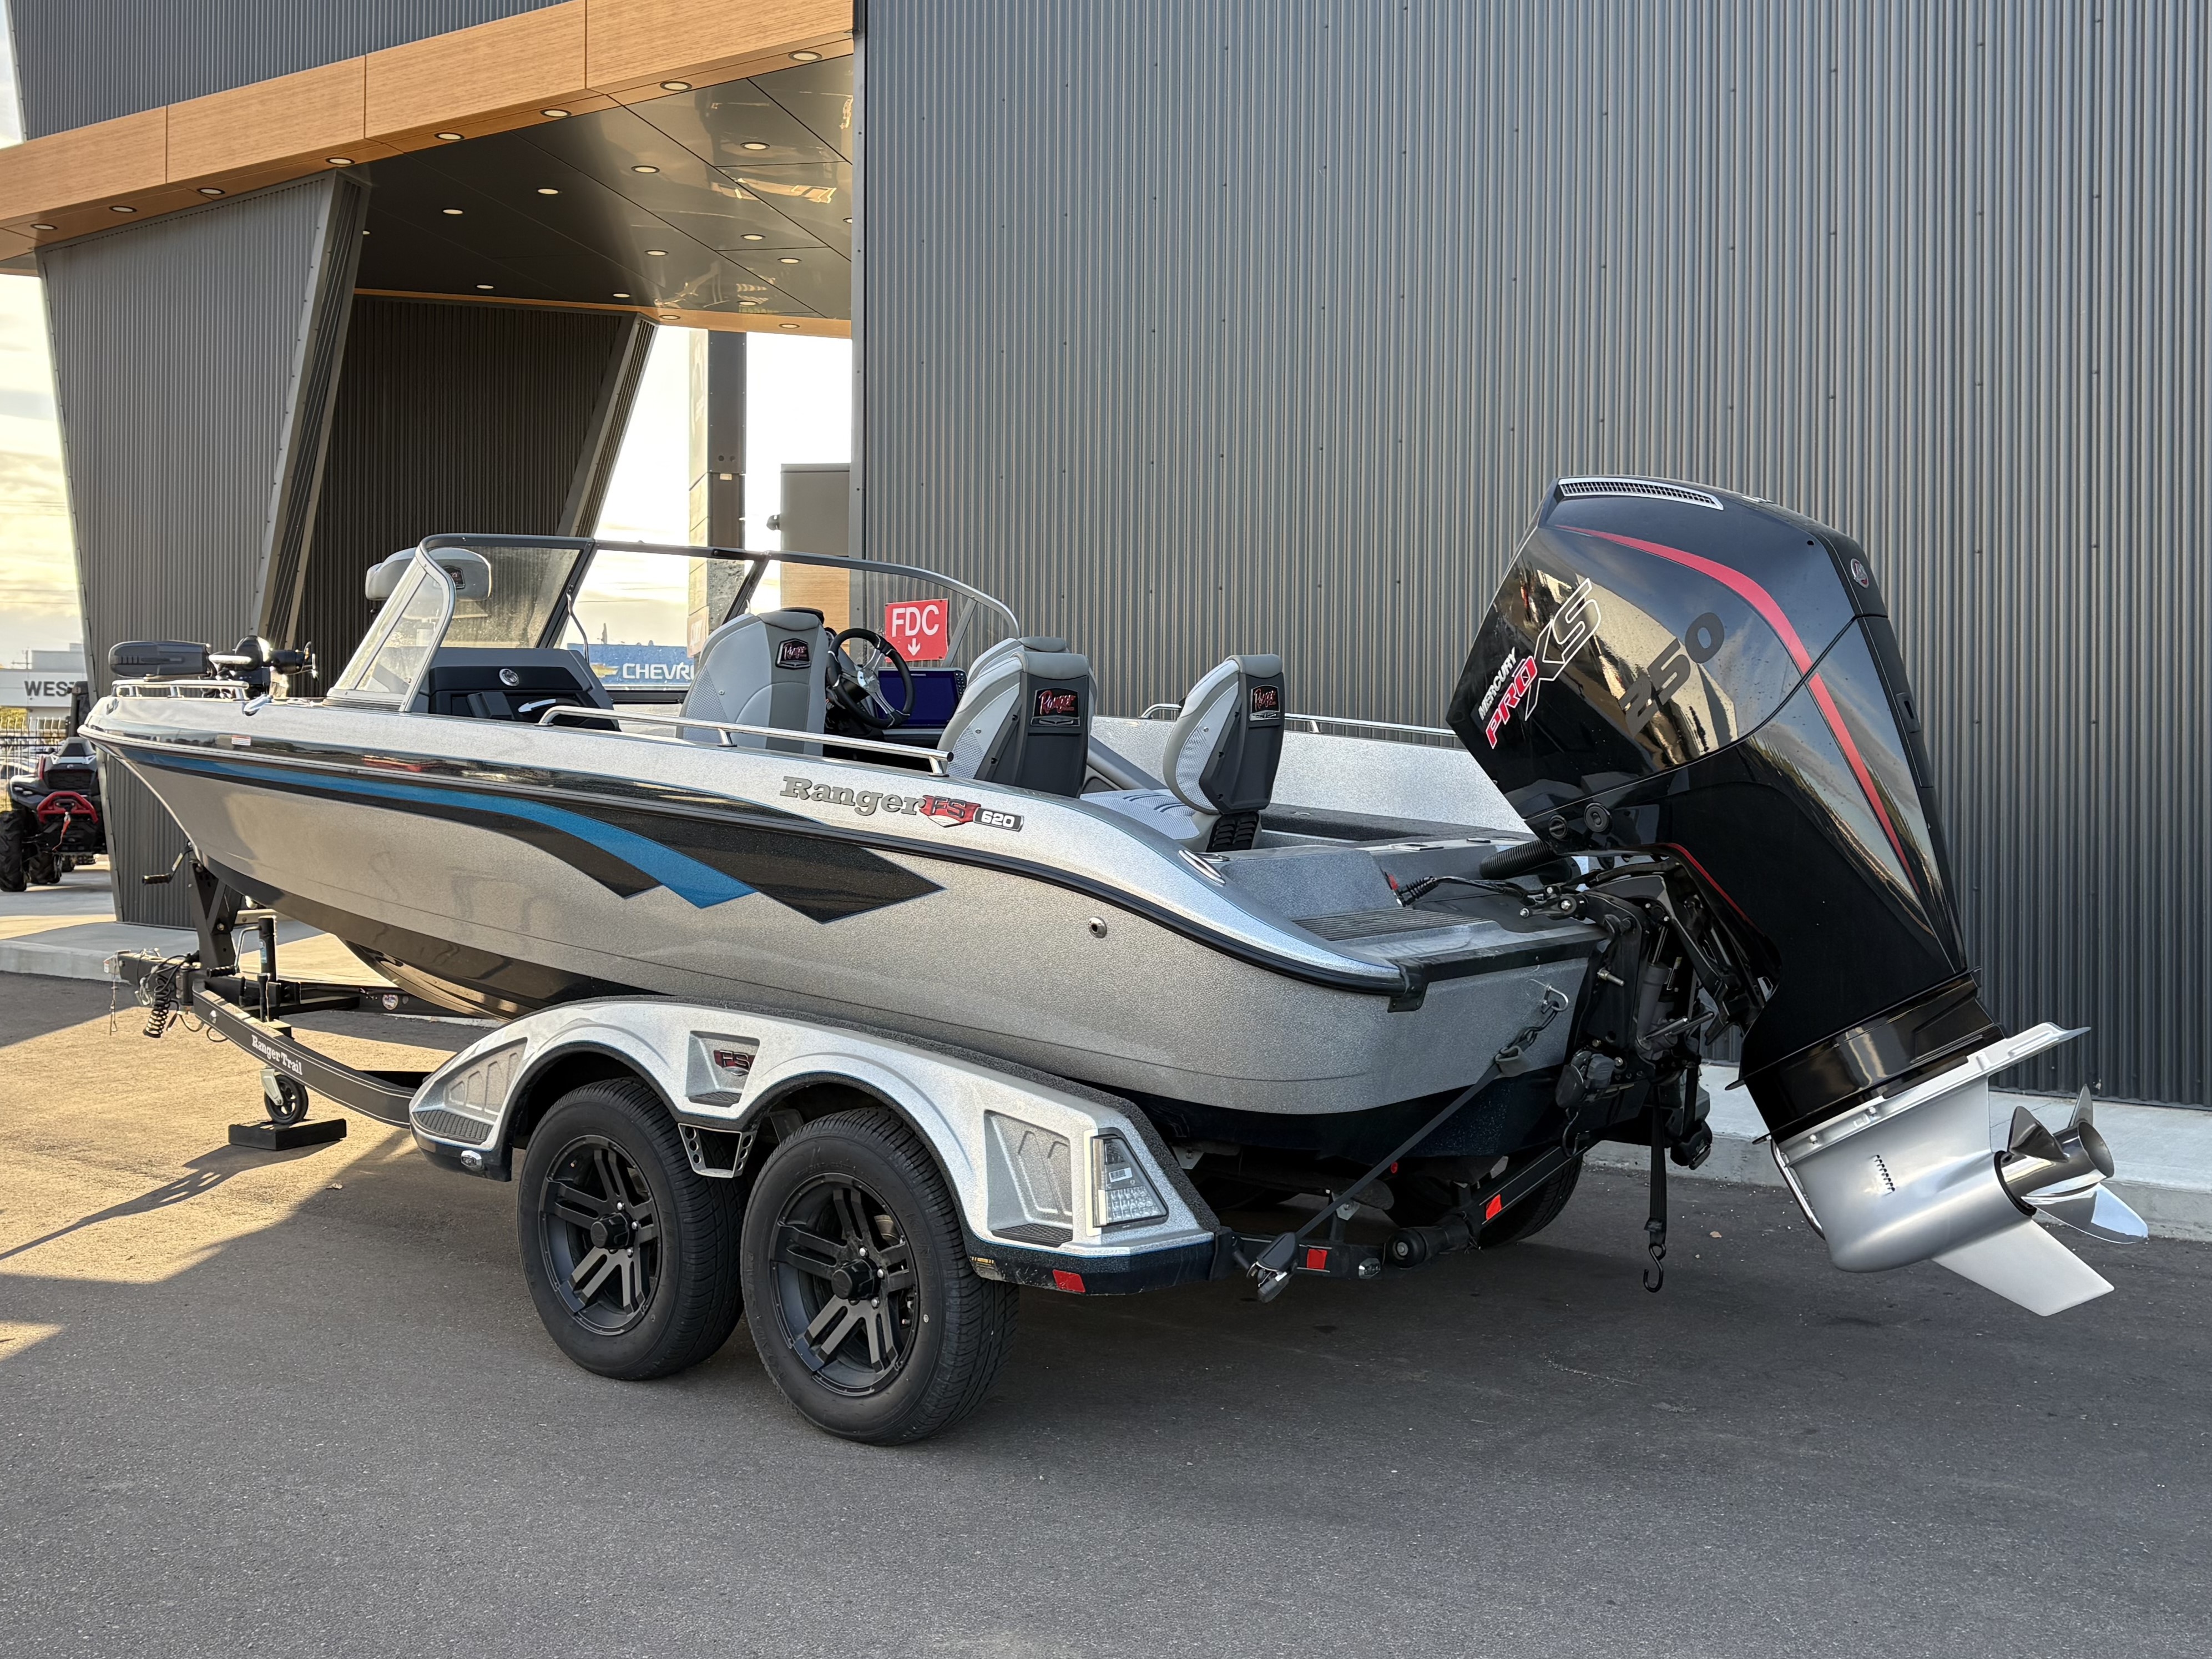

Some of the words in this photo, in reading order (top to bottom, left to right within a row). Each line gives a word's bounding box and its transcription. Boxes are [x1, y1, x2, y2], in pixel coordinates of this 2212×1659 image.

[892, 604, 940, 637] FDC
[622, 663, 694, 680] CHEVR
[1478, 647, 1517, 720] MERCURY
[1486, 655, 1538, 749] PRO
[1525, 578, 1602, 721] XS
[1618, 612, 1725, 737] 250
[24, 680, 75, 697] WES
[779, 776, 926, 816] Ranger
[931, 796, 967, 819] FS
[981, 811, 1016, 828] 620
[251, 1035, 281, 1062] Ranger
[281, 1052, 303, 1075] Trail
[719, 1050, 751, 1068] FS
